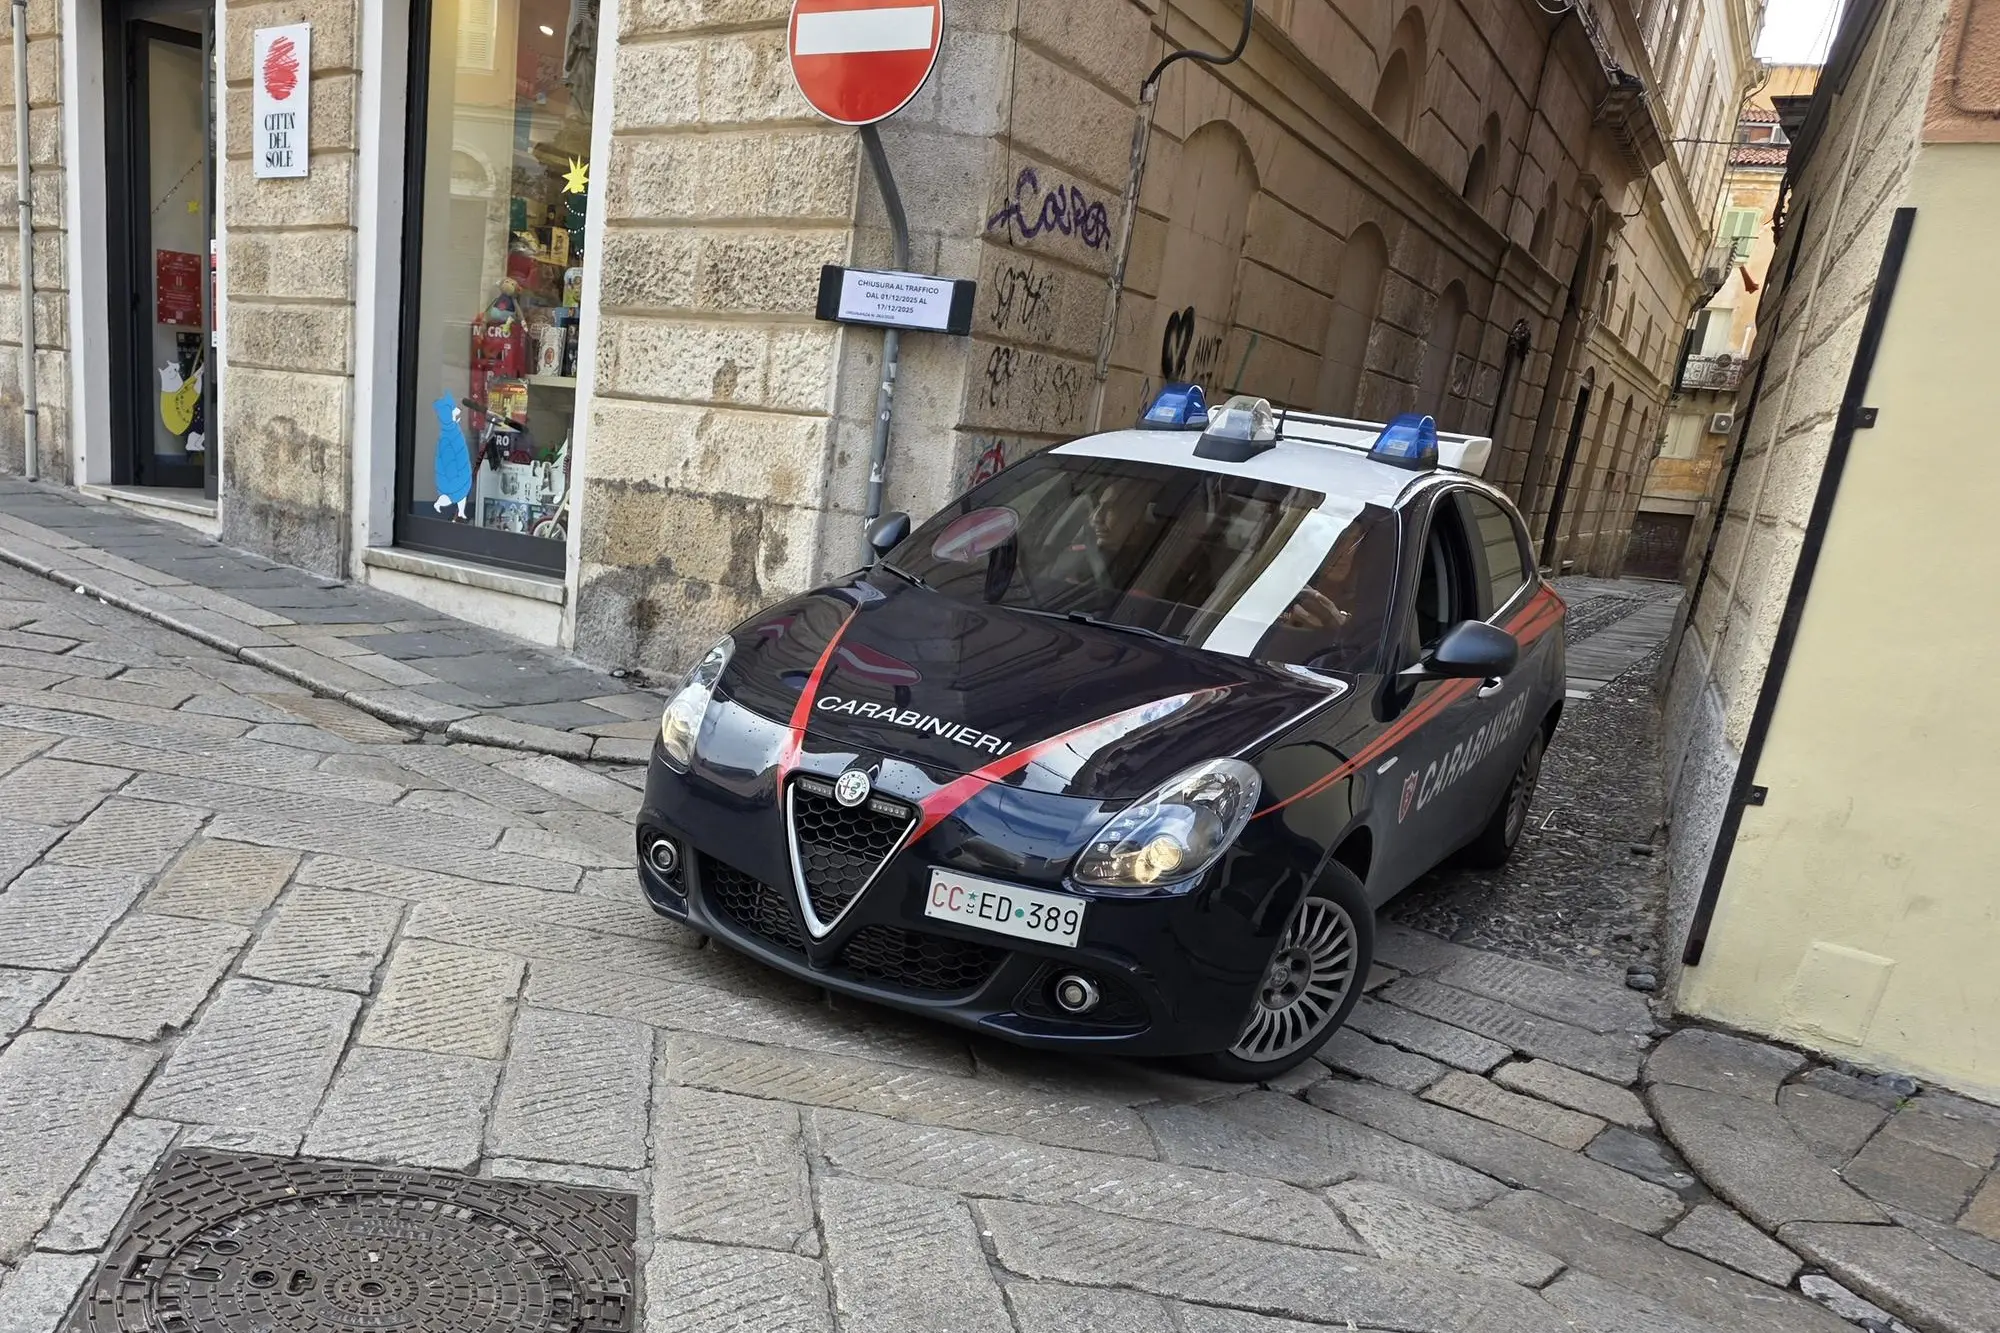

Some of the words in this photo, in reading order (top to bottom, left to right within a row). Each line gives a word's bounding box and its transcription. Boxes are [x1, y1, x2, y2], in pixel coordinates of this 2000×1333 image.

[269, 132, 291, 149] DEL
[265, 150, 294, 168] SOLE
[857, 279, 894, 290] CHIUSURA
[895, 283, 904, 291] AL
[905, 284, 939, 295] TRAFFICO
[866, 291, 879, 300] DAL
[880, 293, 918, 303] 01/12/2025
[919, 297, 928, 305] AL
[877, 303, 914, 314] 17/12/2025
[816, 696, 1013, 756] CARABINIERI
[1416, 686, 1531, 811] CARABINIERI
[1026, 901, 1079, 936] 389
